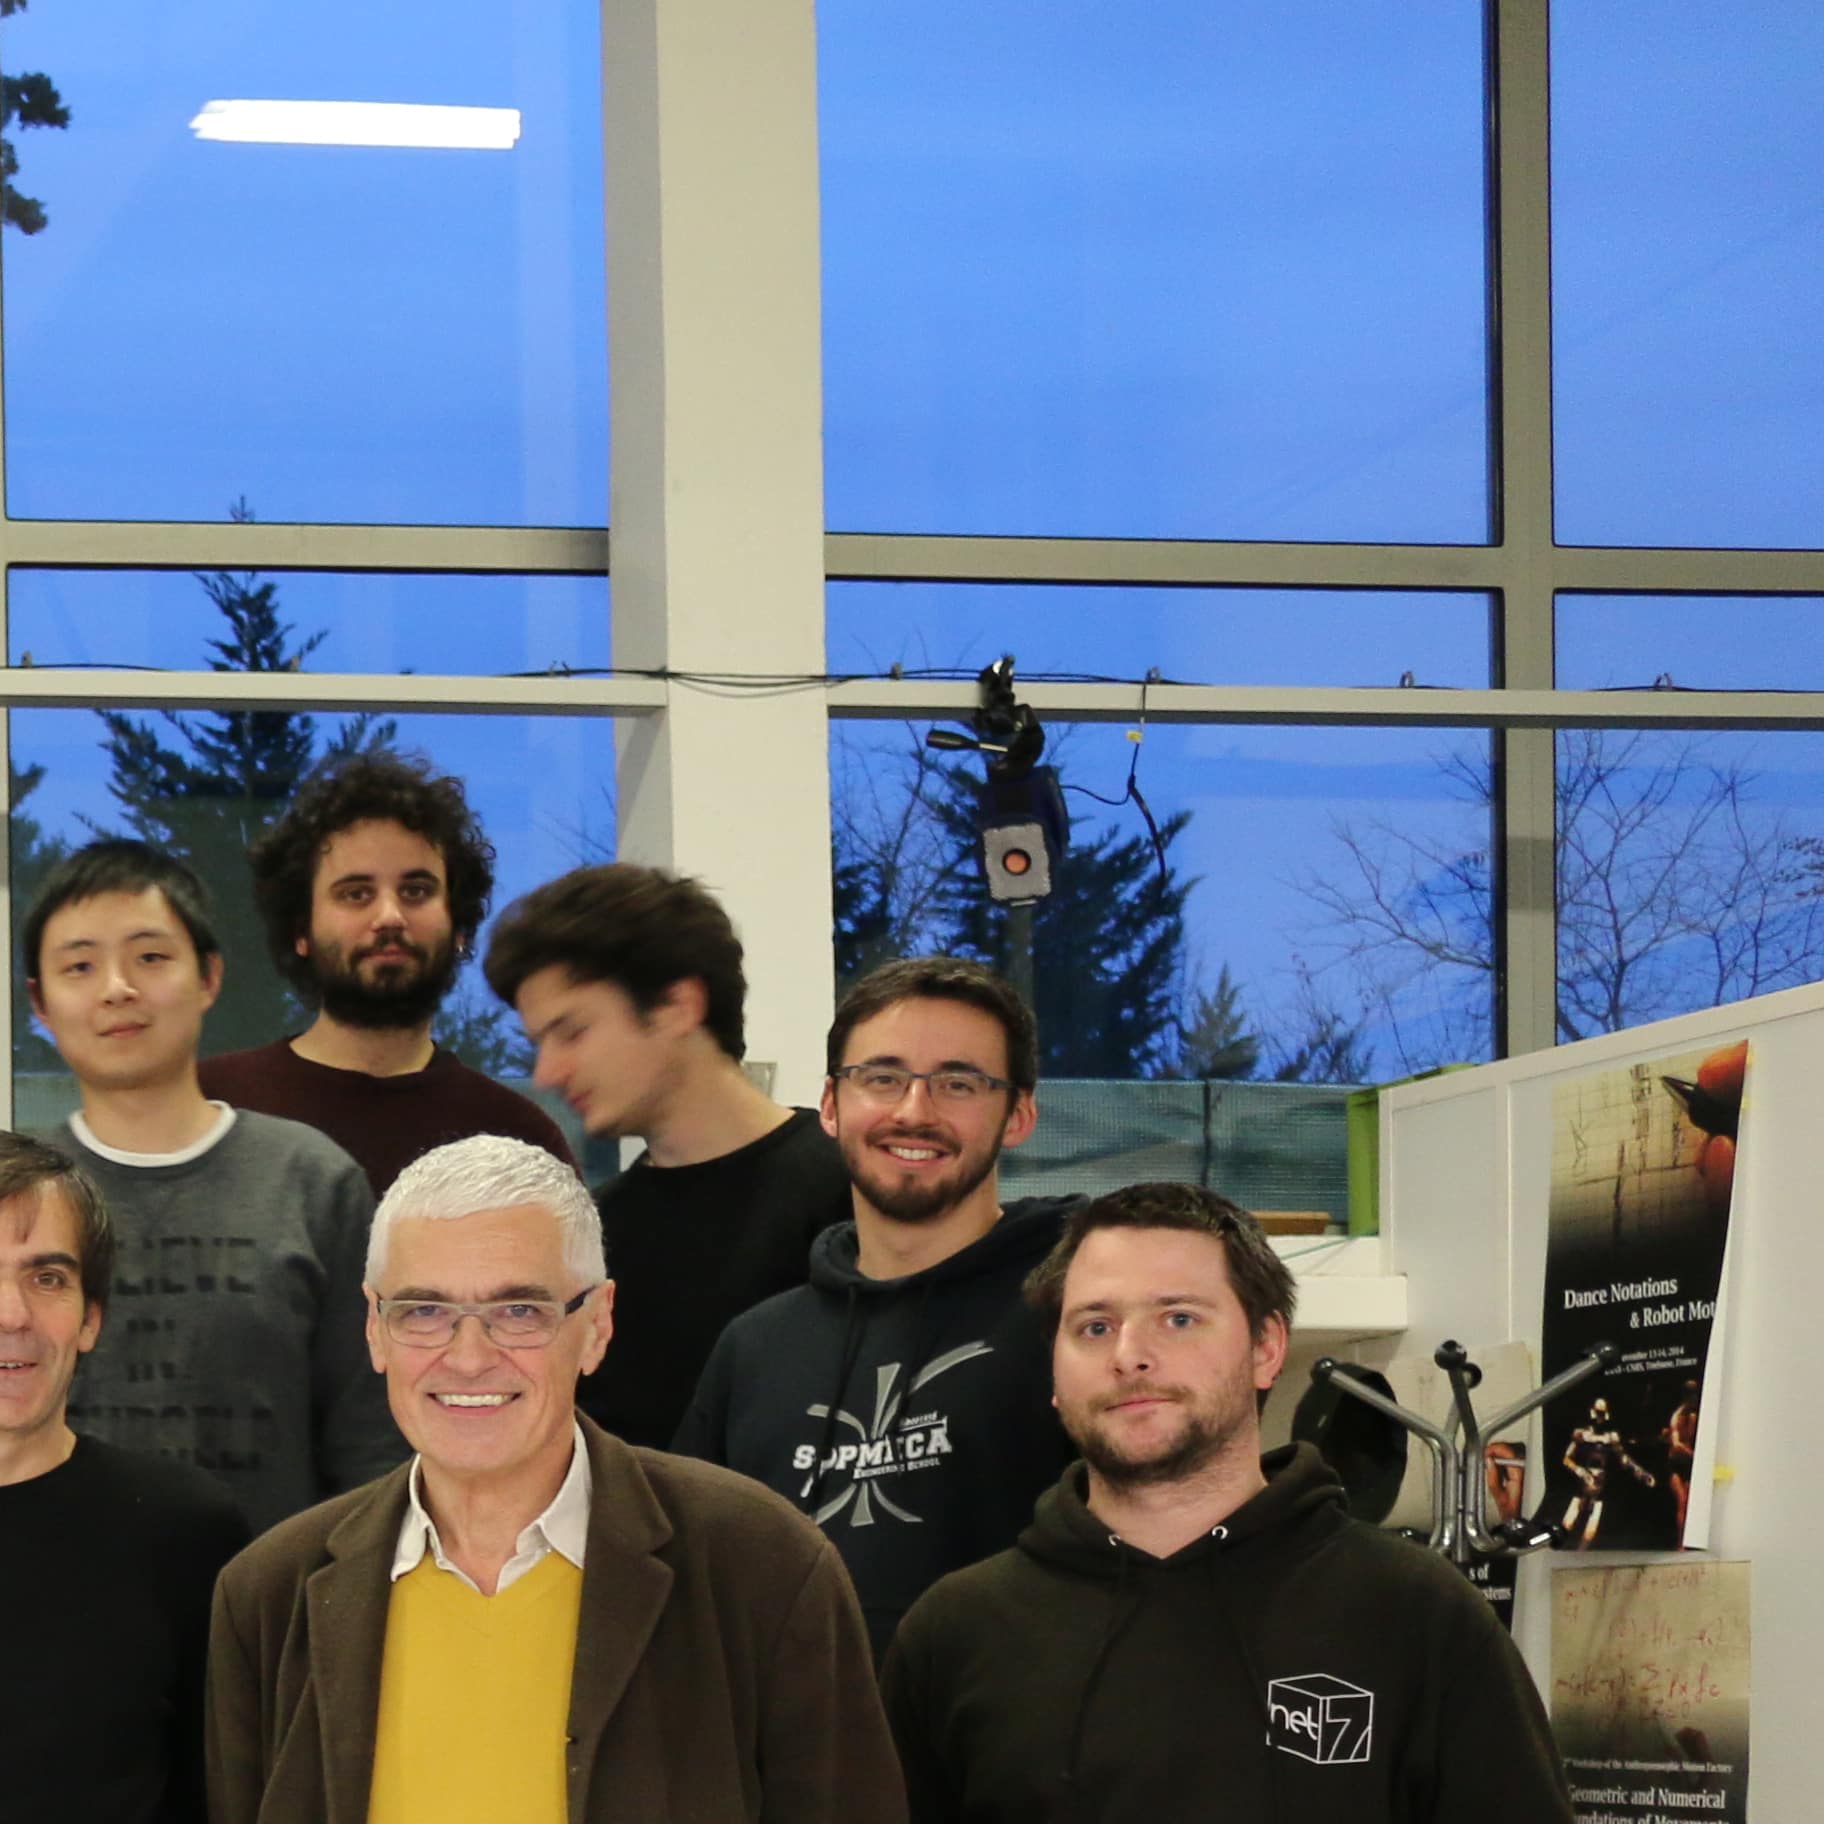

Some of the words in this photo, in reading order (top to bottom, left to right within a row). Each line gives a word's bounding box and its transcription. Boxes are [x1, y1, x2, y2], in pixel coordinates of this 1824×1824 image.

[1564, 1289, 1607, 1309] Dance
[1611, 1278, 1678, 1302] Notations
[1630, 1311, 1640, 1328] &
[1643, 1304, 1685, 1327] Robot
[1477, 1562, 1490, 1580] of
[1631, 1787, 1655, 1805] and
[1658, 1789, 1726, 1809] Numerical
